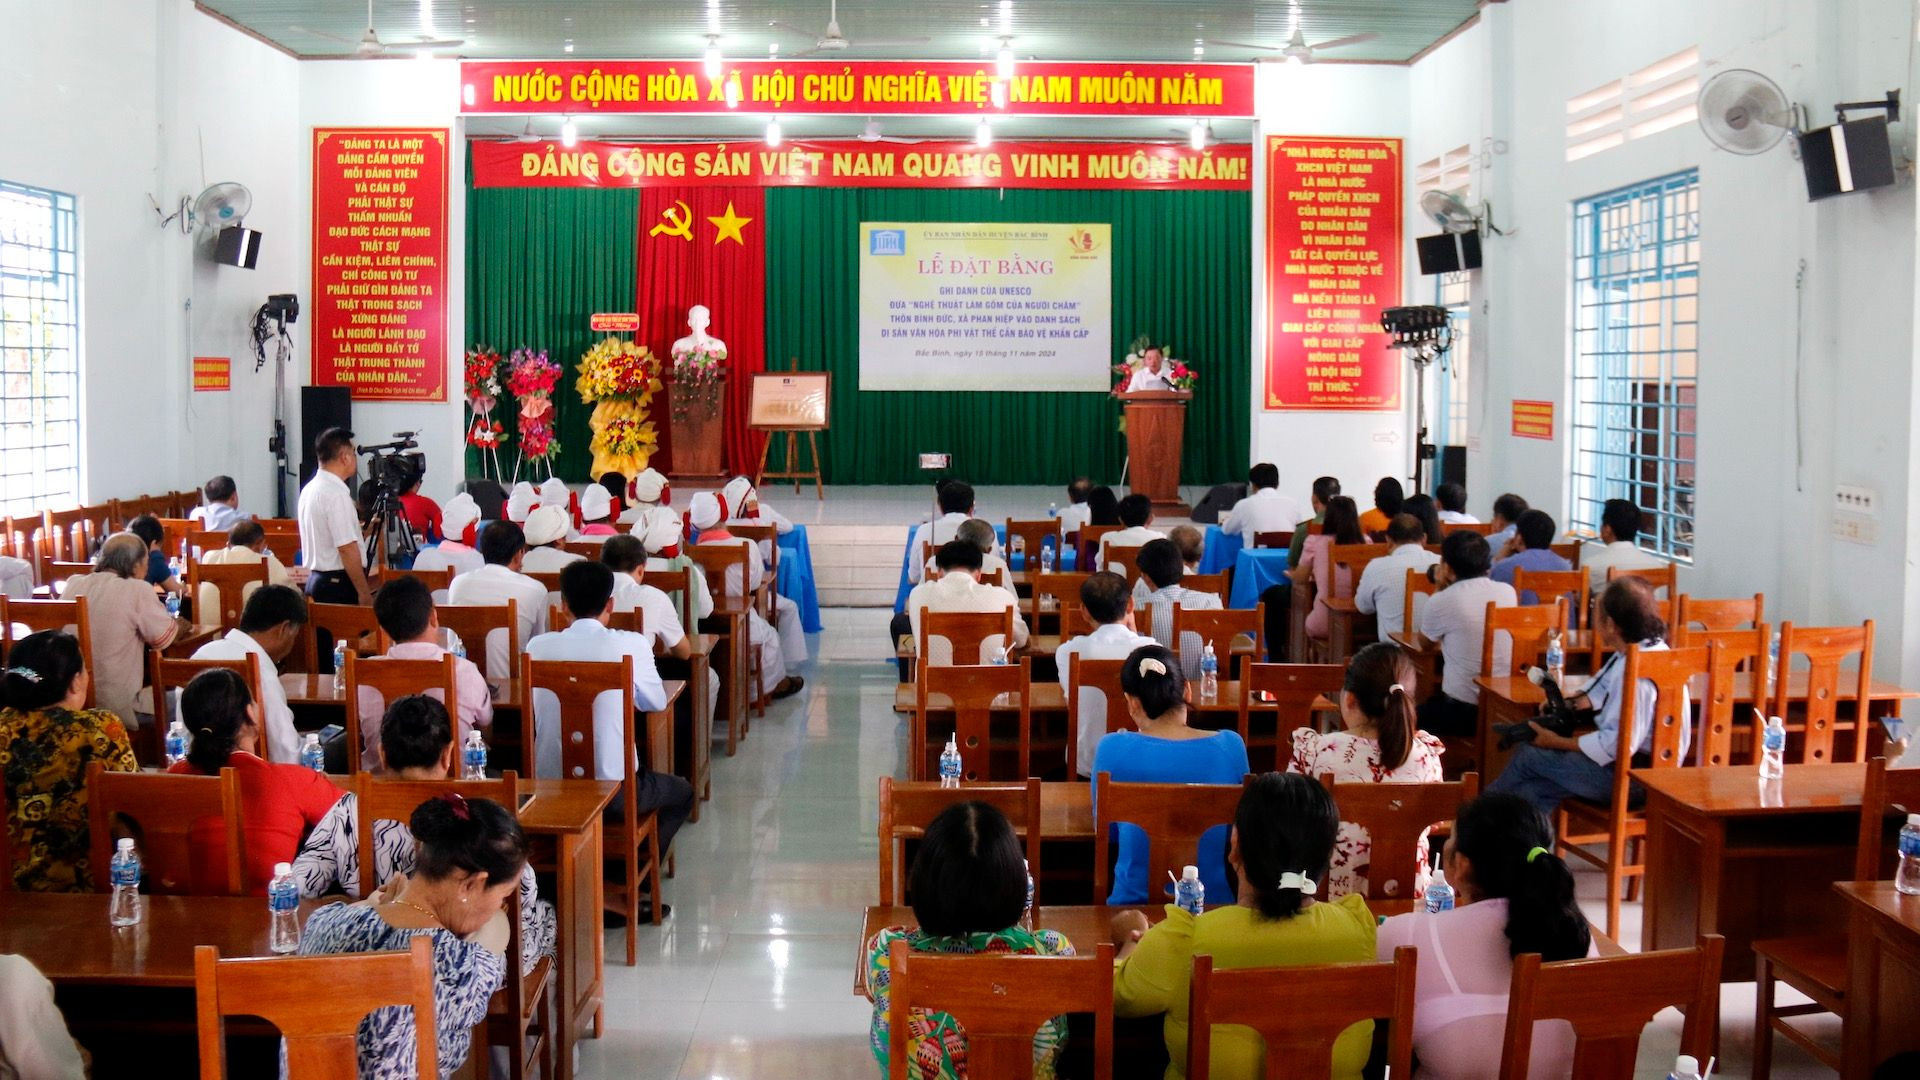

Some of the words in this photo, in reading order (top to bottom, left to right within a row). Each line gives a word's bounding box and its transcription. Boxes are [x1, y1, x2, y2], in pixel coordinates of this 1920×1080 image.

[493, 68, 562, 102] NƯỚC
[570, 69, 639, 107] CỘNG
[647, 68, 698, 102] HÒA
[752, 69, 794, 107] HỘI
[802, 67, 854, 102] CHỦ
[863, 71, 942, 103] NGHĨA
[1010, 76, 1071, 104] NAM
[1079, 71, 1156, 104] MUÔN
[1162, 72, 1223, 104] NĂM
[374, 140, 386, 149] TA
[388, 138, 400, 149] LÀ
[402, 138, 424, 151] MỘT
[337, 152, 364, 164] ĐẢNG
[366, 152, 389, 164] CẦM
[392, 151, 424, 165] QUYỀN
[522, 145, 599, 177] ĐẢNG
[607, 148, 685, 183] CỘNG
[694, 145, 750, 177] SẢN
[759, 148, 824, 181] VIỆT
[833, 153, 894, 177] NAM
[903, 153, 1002, 178] QUANG
[1010, 153, 1080, 178] VINH
[1088, 150, 1170, 179] MUÔN
[1177, 151, 1247, 180] NĂM!
[344, 166, 363, 178] MỖI
[365, 167, 392, 178] ĐẢNG
[394, 168, 418, 178] VIÊN
[355, 182, 368, 192] VÀ
[370, 182, 390, 192] CÁN
[392, 182, 406, 194] BỘ
[348, 196, 371, 208] PHẢI
[374, 196, 397, 209] THẬT
[400, 197, 414, 209] SỰ
[348, 210, 375, 222] THẤM
[378, 210, 412, 222] NHUẦN
[329, 227, 348, 238] ĐẠO
[350, 226, 370, 236] ĐỨC
[373, 226, 398, 236] CÁCH
[401, 228, 430, 238] MẠNG
[360, 240, 383, 252] THẬT
[386, 241, 400, 252] SỰ
[323, 254, 342, 265] CẦN
[346, 256, 373, 267] KIỆM,
[376, 256, 400, 265] LIÊM
[403, 256, 436, 266] CHÍNH,
[342, 270, 358, 280] CHÍ
[361, 270, 387, 280] CÔNG
[390, 270, 402, 280] VÔ
[405, 270, 418, 280] TƯ
[327, 284, 349, 294] PHẢI
[352, 285, 370, 294] GIỮ
[371, 285, 388, 294] GÌN
[391, 284, 418, 295] ĐẢNG
[420, 286, 432, 295] TA
[336, 299, 359, 308] THẬT
[362, 300, 393, 309] TRONG
[396, 300, 422, 311] SẠCH
[352, 314, 377, 323] XỨNG
[380, 314, 407, 324] ĐÁNG
[333, 328, 344, 338] LÀ
[347, 328, 376, 338] NGƯỜI
[379, 328, 404, 338] LÃNH
[406, 329, 426, 340] ĐẠO
[340, 344, 351, 352] LÀ
[354, 343, 383, 352] NGƯỜI
[386, 342, 404, 352] ĐẦY
[407, 343, 419, 353] TỚ
[334, 358, 356, 366] THẬT
[359, 358, 390, 367] TRUNG
[394, 358, 425, 368] THÀNH
[336, 370, 354, 382] CỦA
[358, 372, 384, 382] NHÂN
